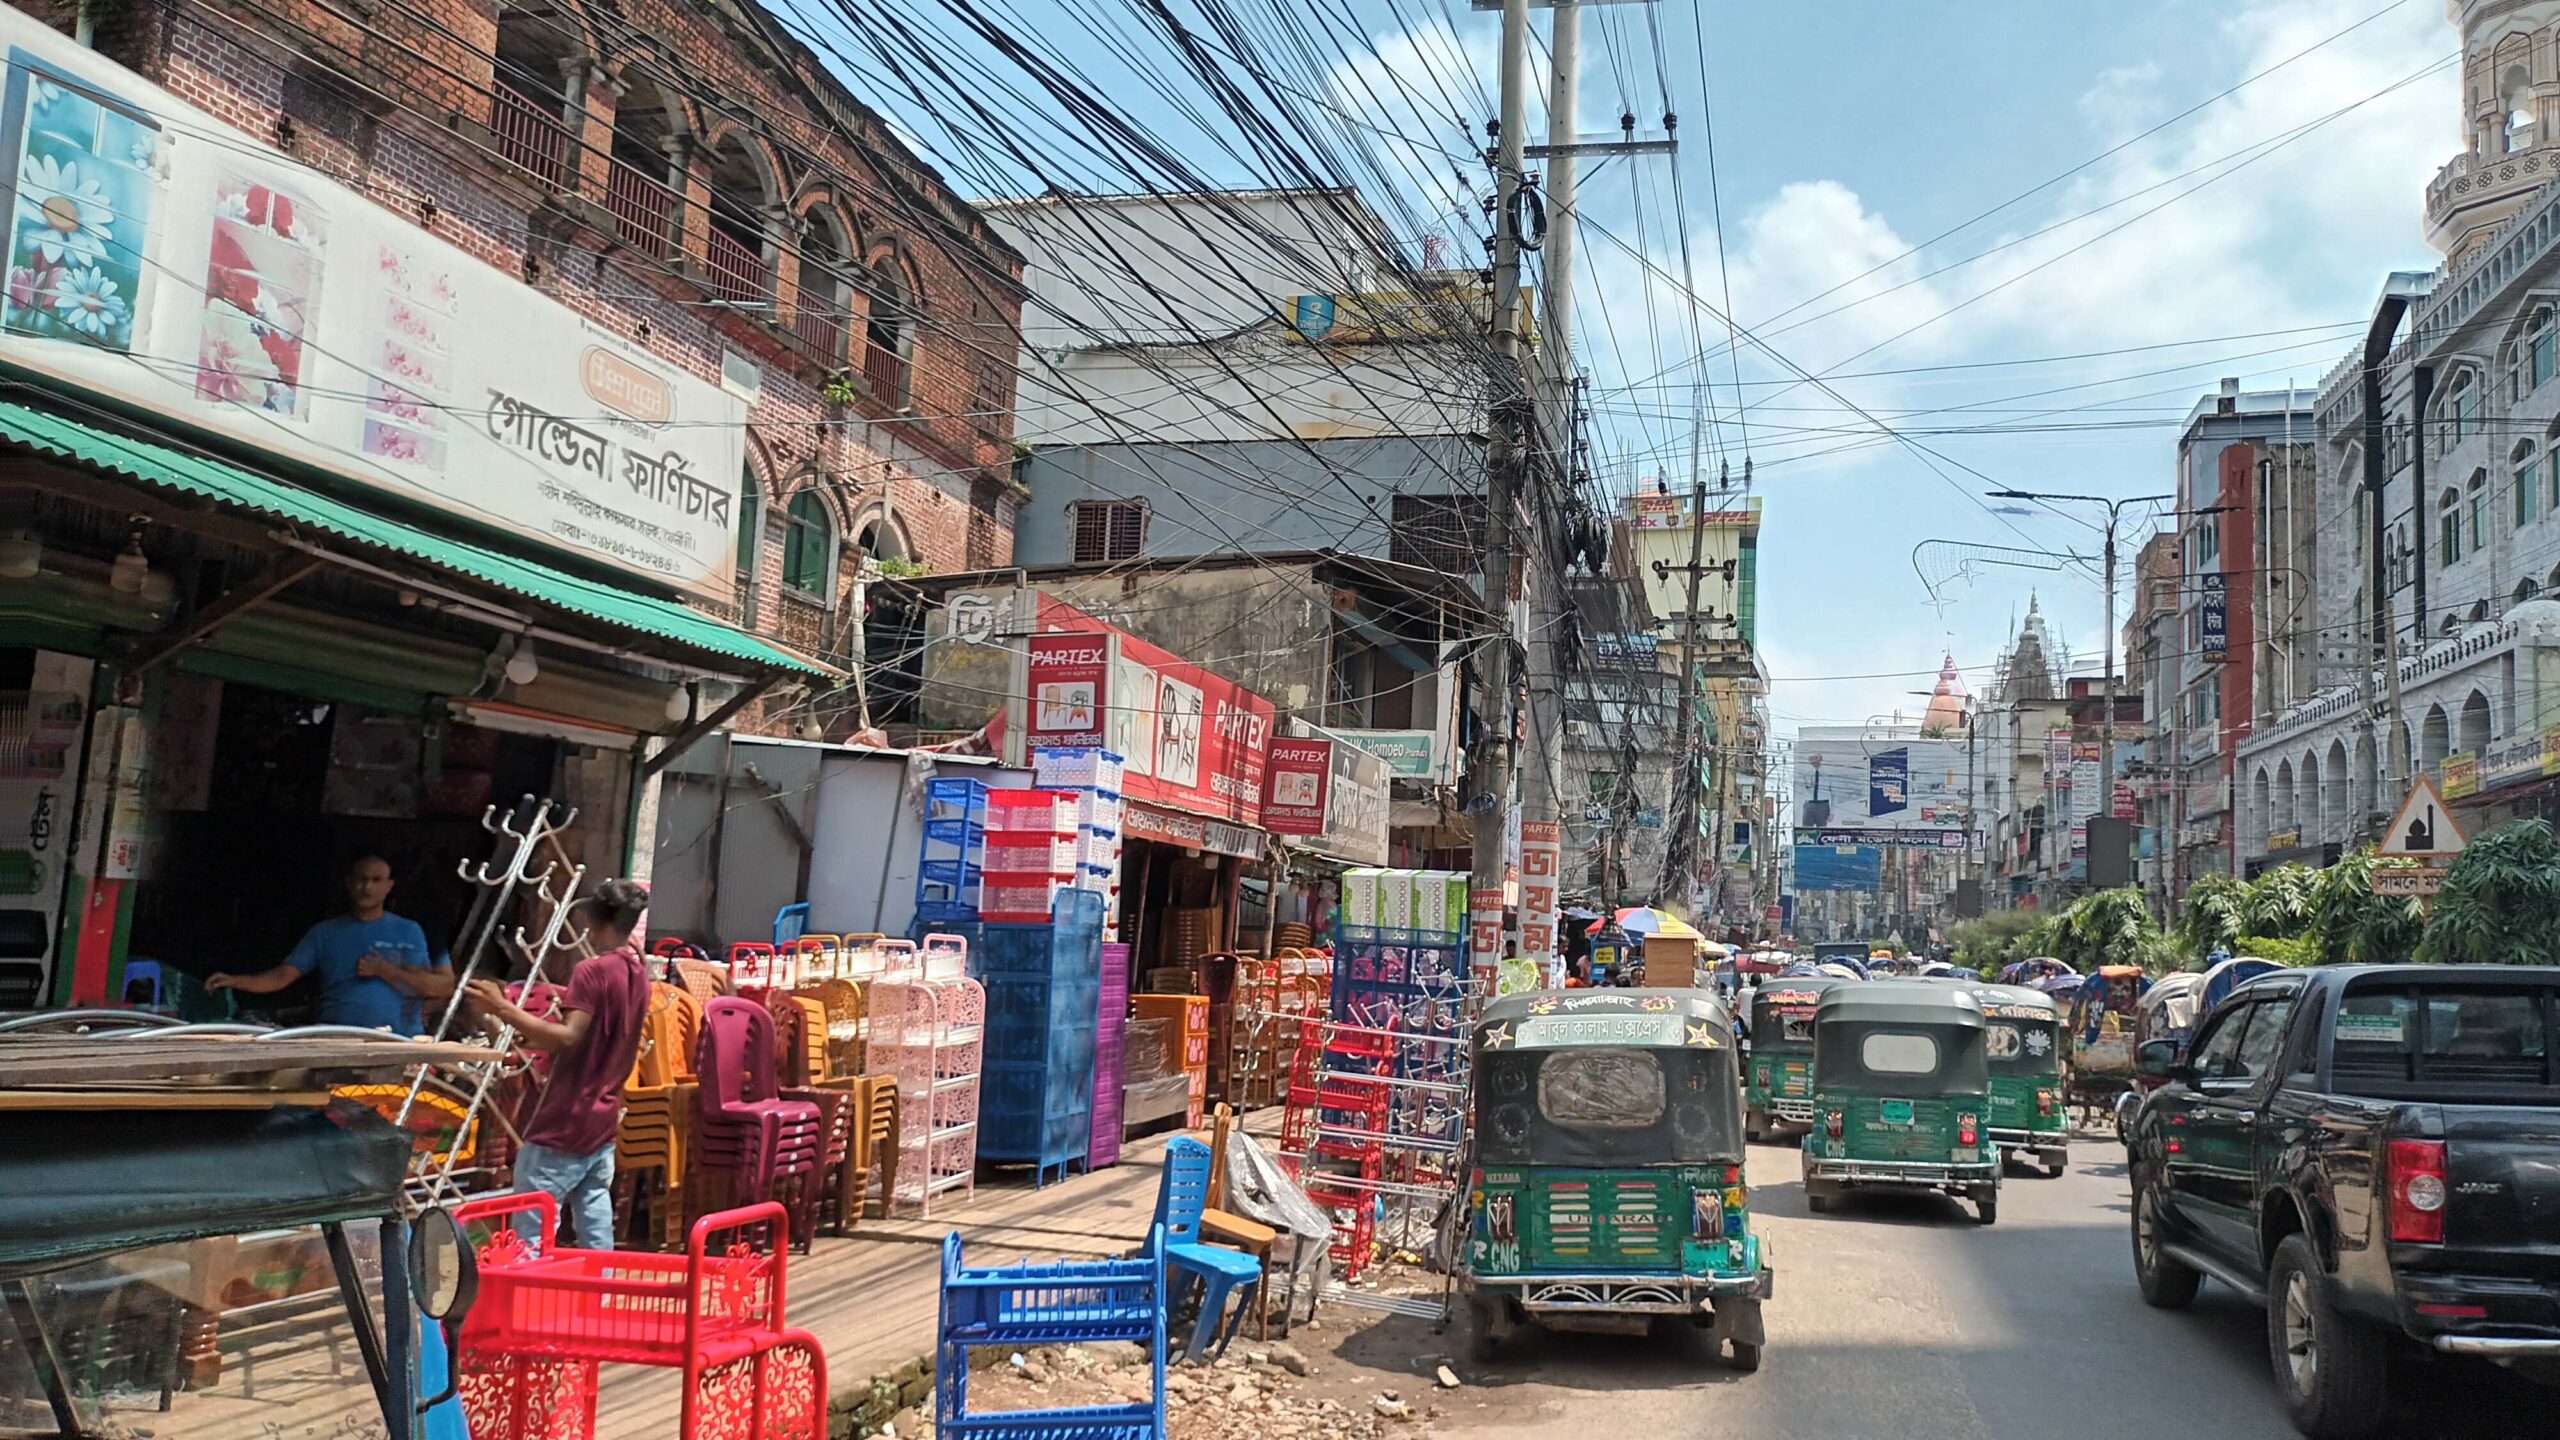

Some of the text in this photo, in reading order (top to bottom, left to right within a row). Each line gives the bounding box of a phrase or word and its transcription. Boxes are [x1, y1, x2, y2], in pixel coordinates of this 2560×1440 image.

[487, 387, 613, 482] গোল্ডেন
[1030, 648, 1105, 667] PARTEX
[1214, 698, 1267, 752] PARTEX
[1271, 748, 1327, 763] PARTEX
[1367, 738, 1404, 758] Homoeo
[2378, 875, 2418, 890] সামনে
[1536, 1019, 1662, 1043] আবুল কালাম এক্সপ্রেস
[1825, 1140, 1846, 1158] CNG
[1491, 1241, 1520, 1273] CNG
